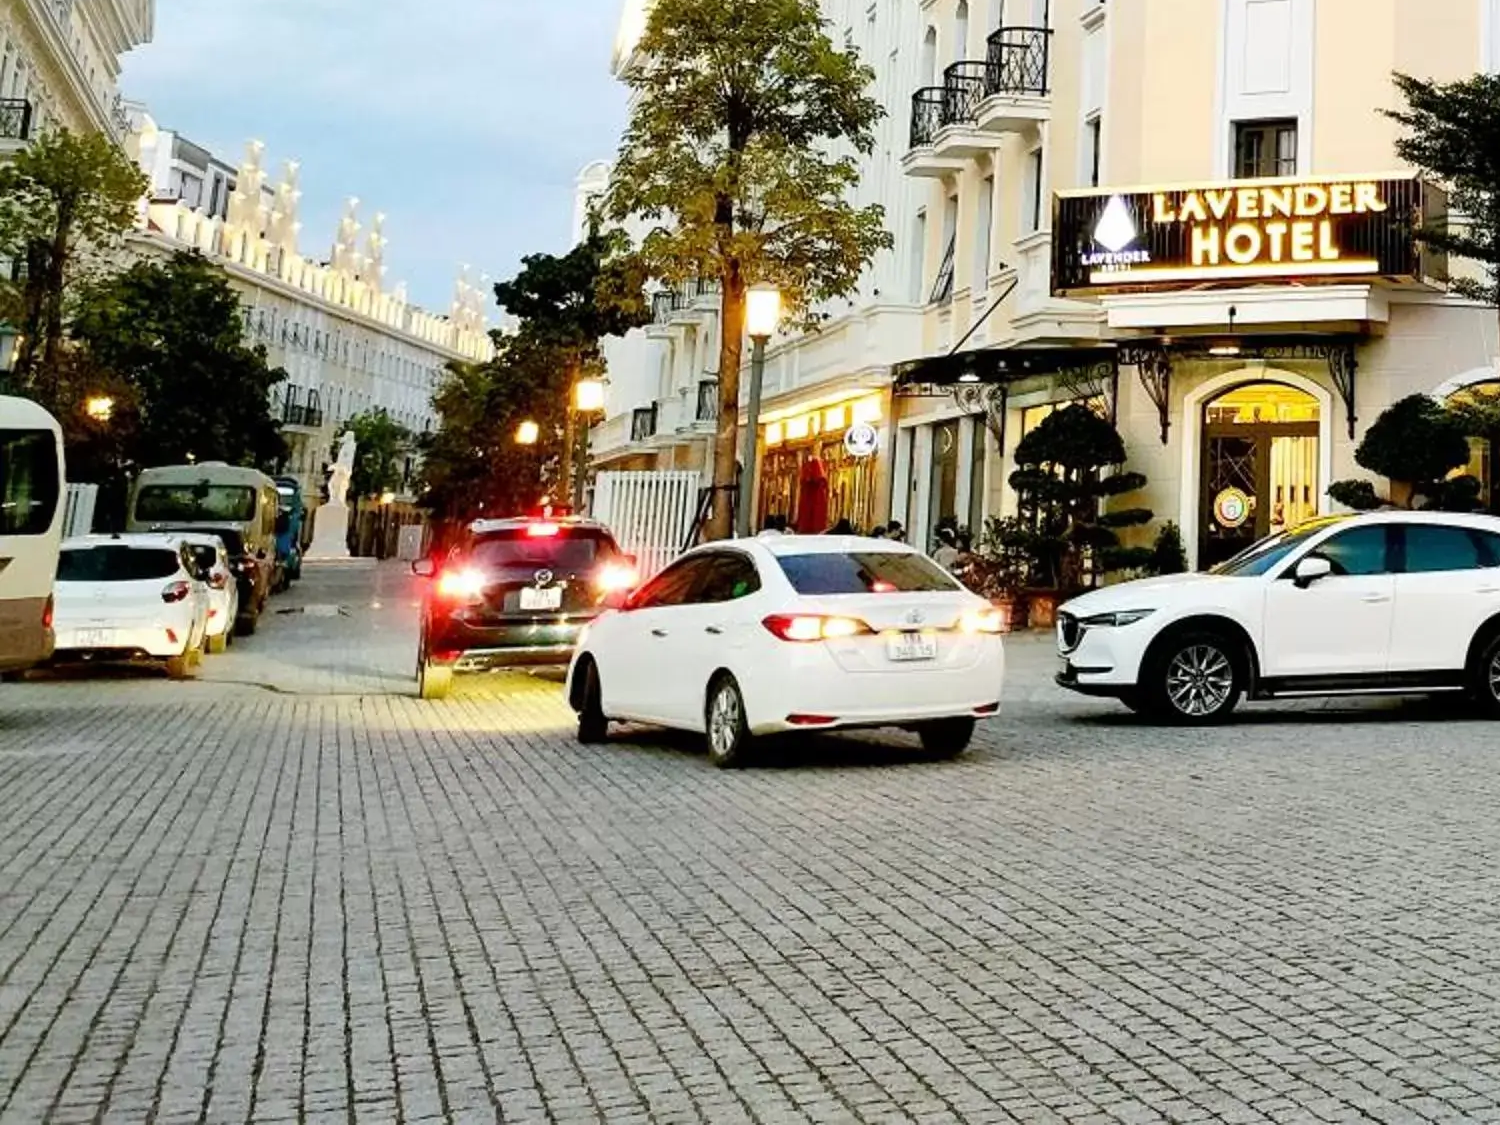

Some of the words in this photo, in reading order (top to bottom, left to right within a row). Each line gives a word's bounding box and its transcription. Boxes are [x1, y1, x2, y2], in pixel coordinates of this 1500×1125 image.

[1153, 183, 1387, 222] LAVENDER
[1081, 250, 1151, 265] LAVENDER
[1191, 220, 1339, 265] HOTEL
